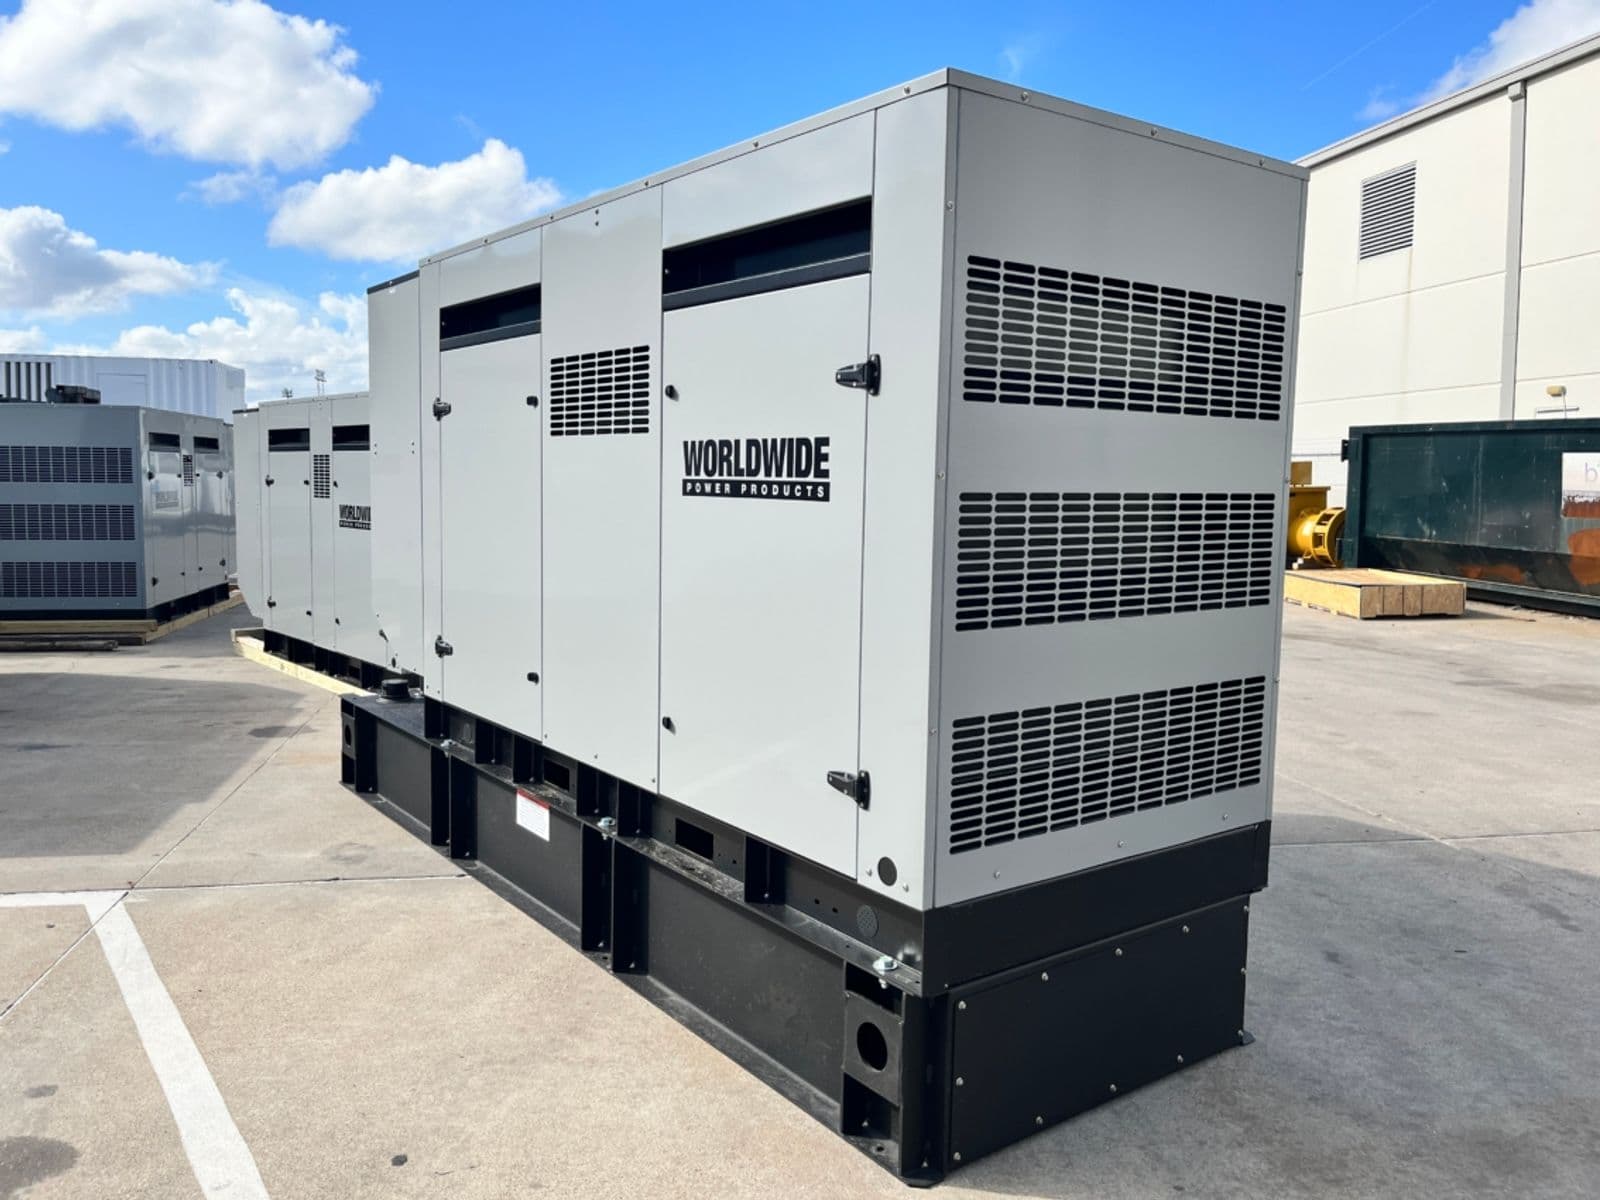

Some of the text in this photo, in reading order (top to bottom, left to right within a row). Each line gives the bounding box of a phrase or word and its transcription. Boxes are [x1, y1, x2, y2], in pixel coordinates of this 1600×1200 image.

[682, 437, 830, 478] WORLDWIDE
[686, 482, 824, 498] POWER PRODUCTS
[339, 504, 371, 521] WORLDWI
